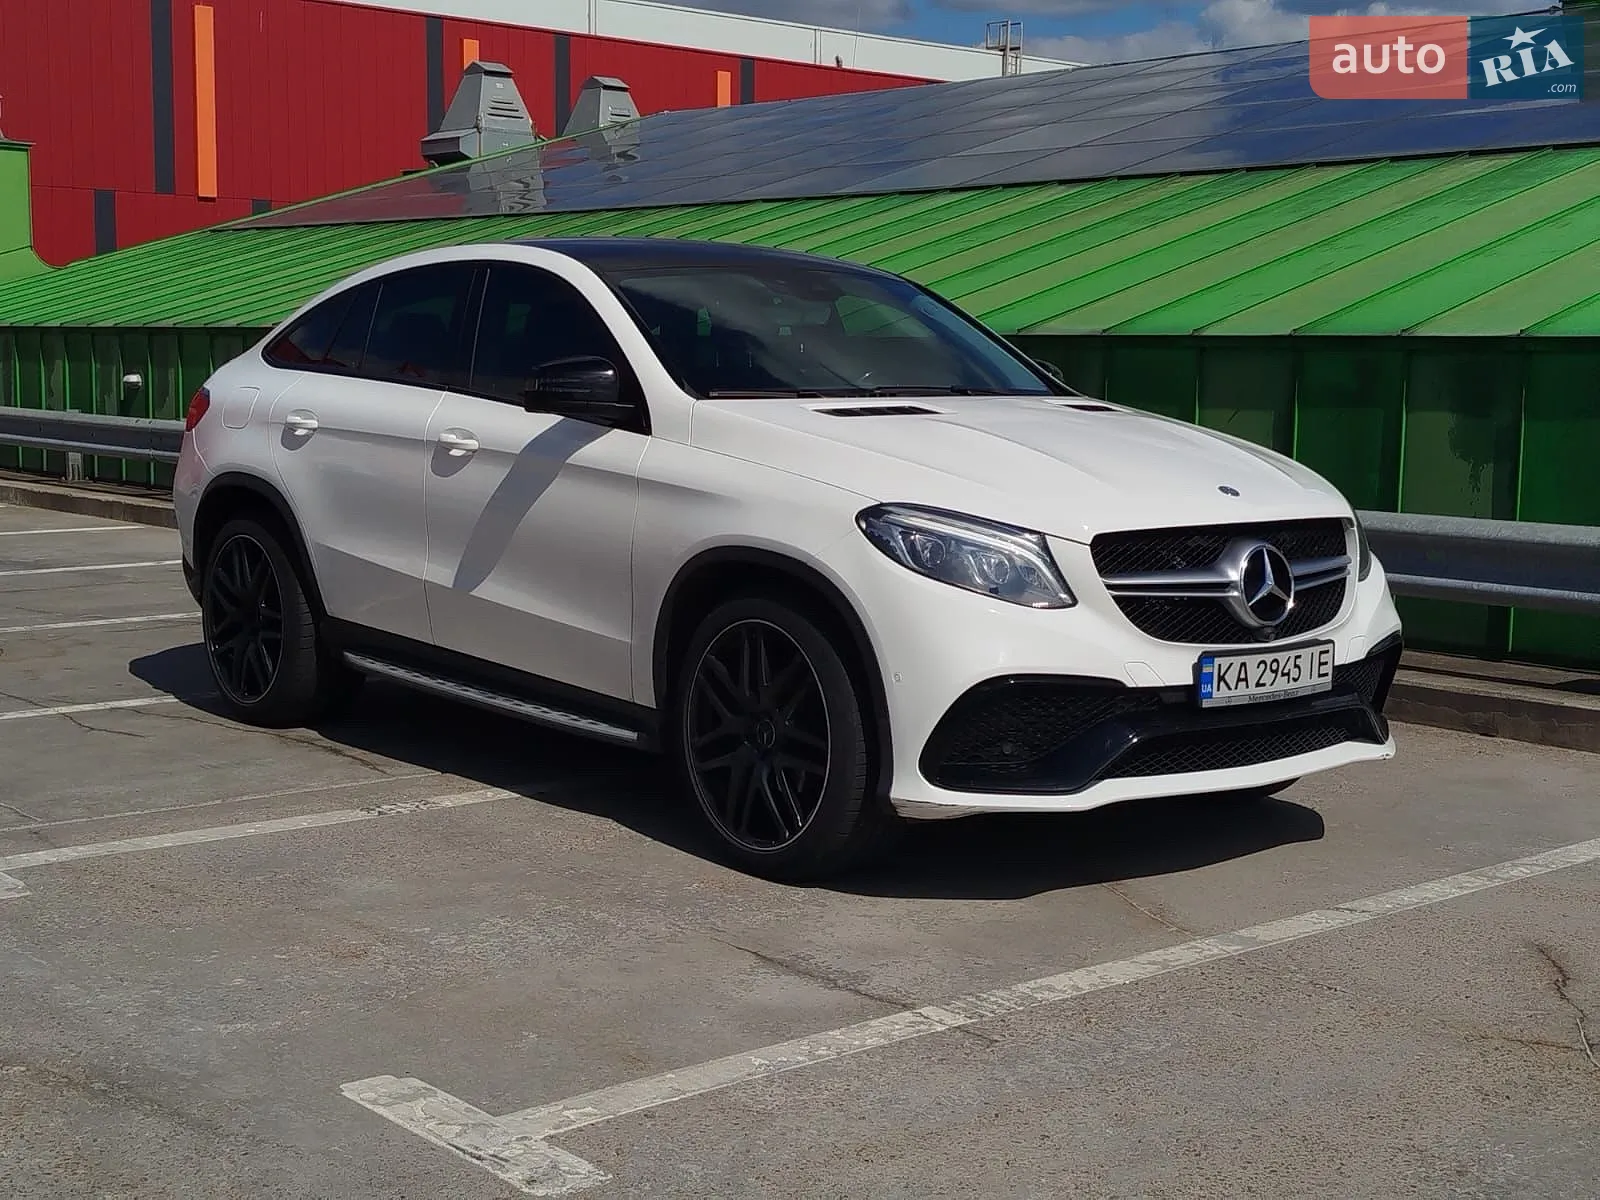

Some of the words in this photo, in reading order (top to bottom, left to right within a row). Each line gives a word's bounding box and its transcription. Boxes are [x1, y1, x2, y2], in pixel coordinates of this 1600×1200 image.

[1216, 661, 1250, 692] KA
[1254, 654, 1302, 688] 2945
[1309, 649, 1330, 680] IE
[1201, 685, 1212, 693] UA
